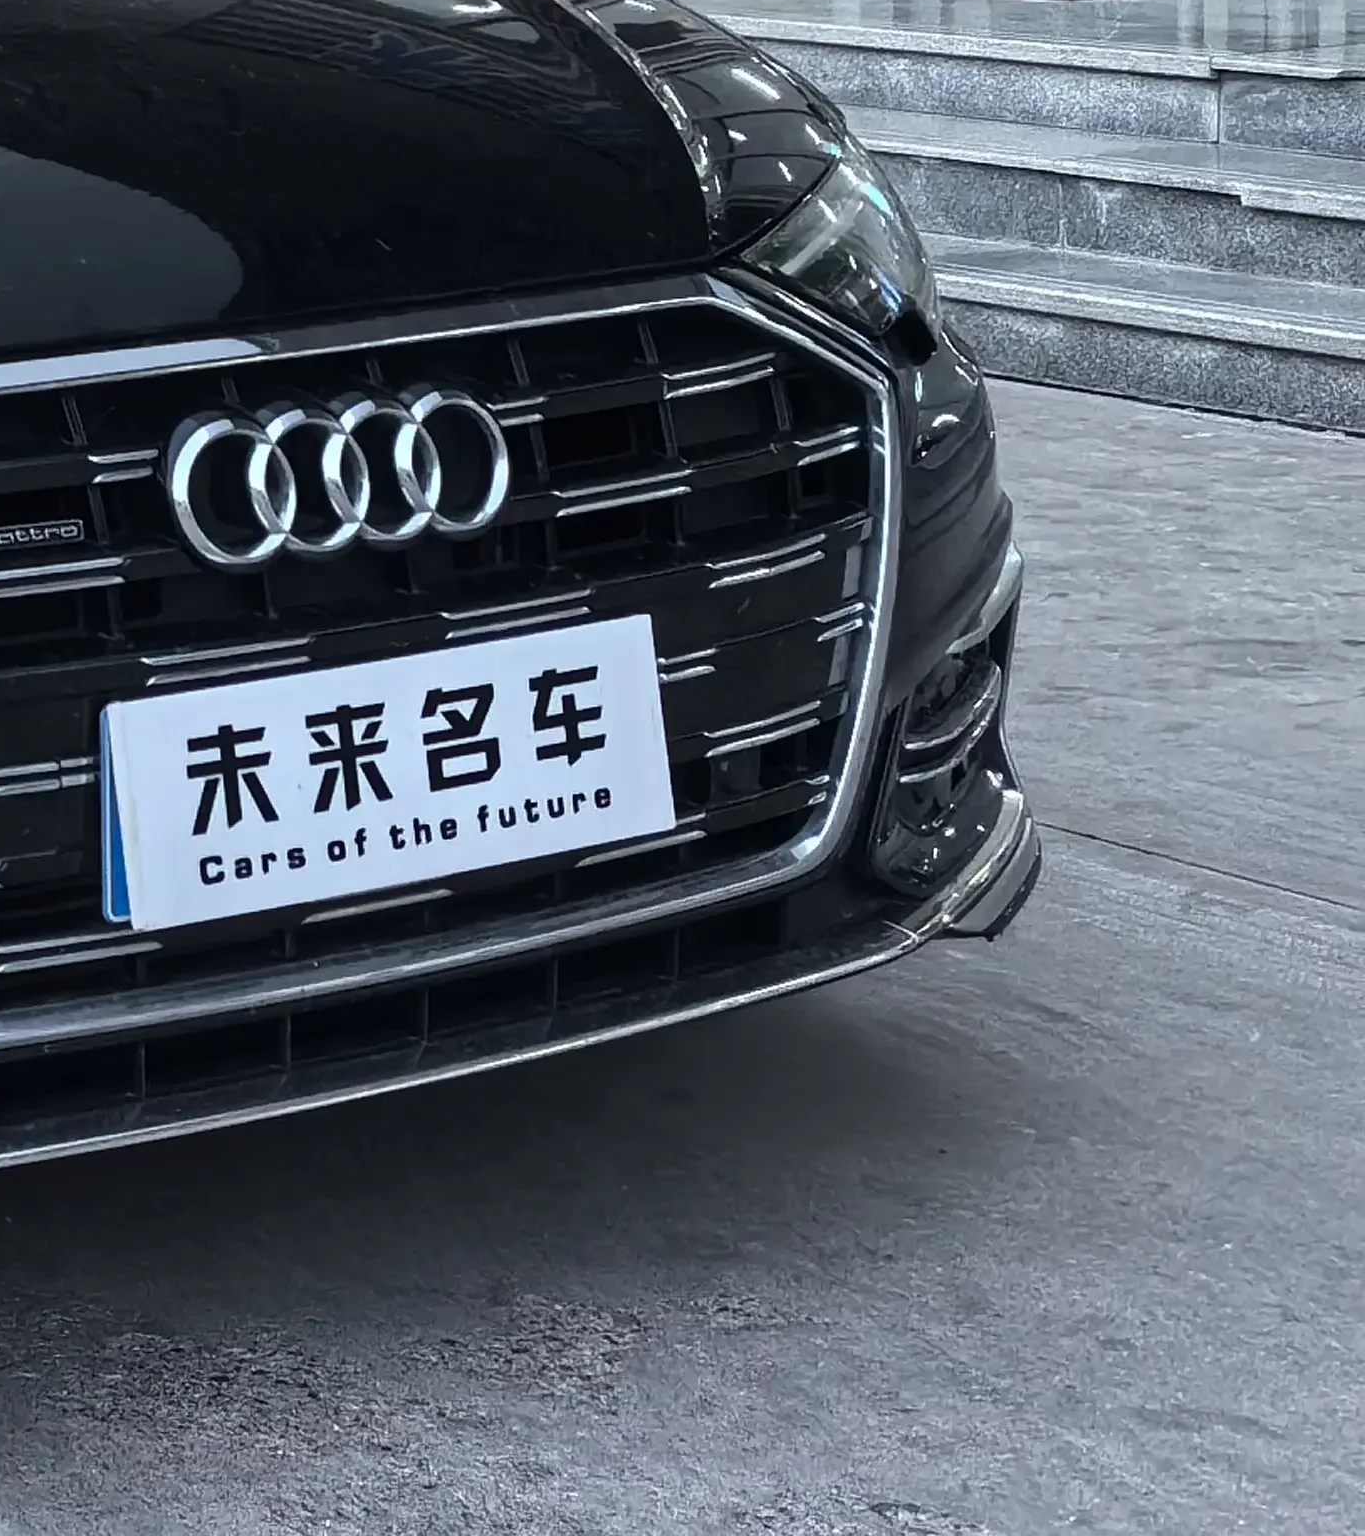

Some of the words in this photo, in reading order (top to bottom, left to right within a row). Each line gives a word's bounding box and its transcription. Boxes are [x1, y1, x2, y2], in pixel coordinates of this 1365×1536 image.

[186, 666, 607, 836] 未来名车
[199, 846, 307, 886] Cars
[327, 827, 367, 862] of
[389, 817, 459, 854] the
[477, 786, 612, 833] future
